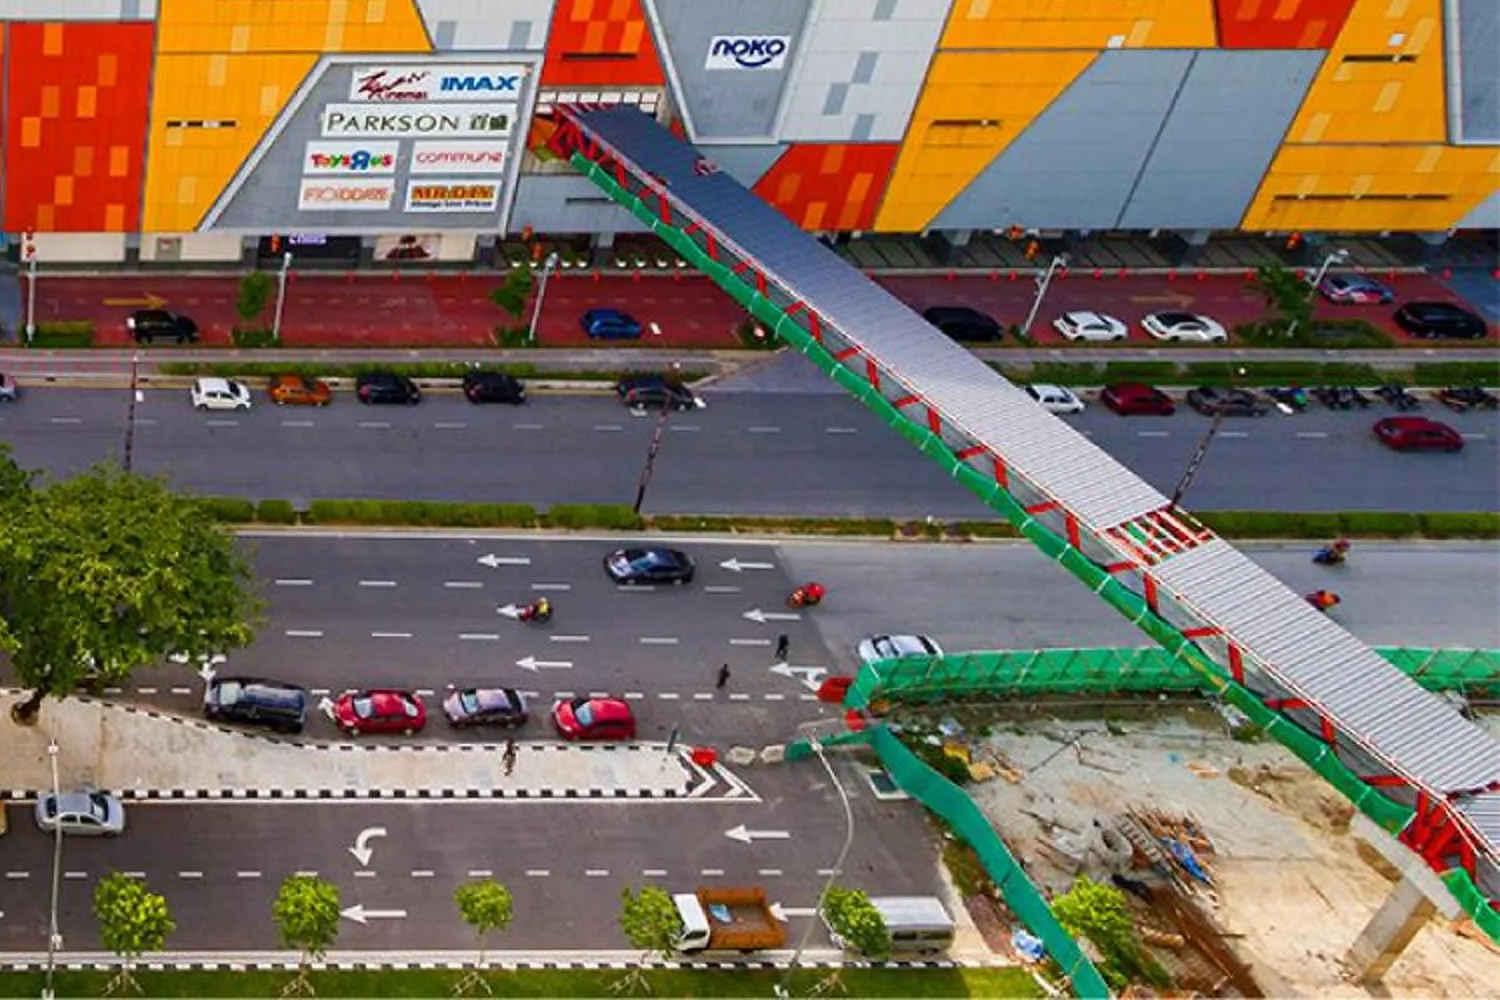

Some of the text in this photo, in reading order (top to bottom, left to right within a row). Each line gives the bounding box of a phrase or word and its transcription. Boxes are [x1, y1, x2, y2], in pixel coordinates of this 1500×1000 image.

[440, 75, 518, 91] IMAX
[326, 113, 460, 132] PARKSON
[416, 151, 503, 163] commune
